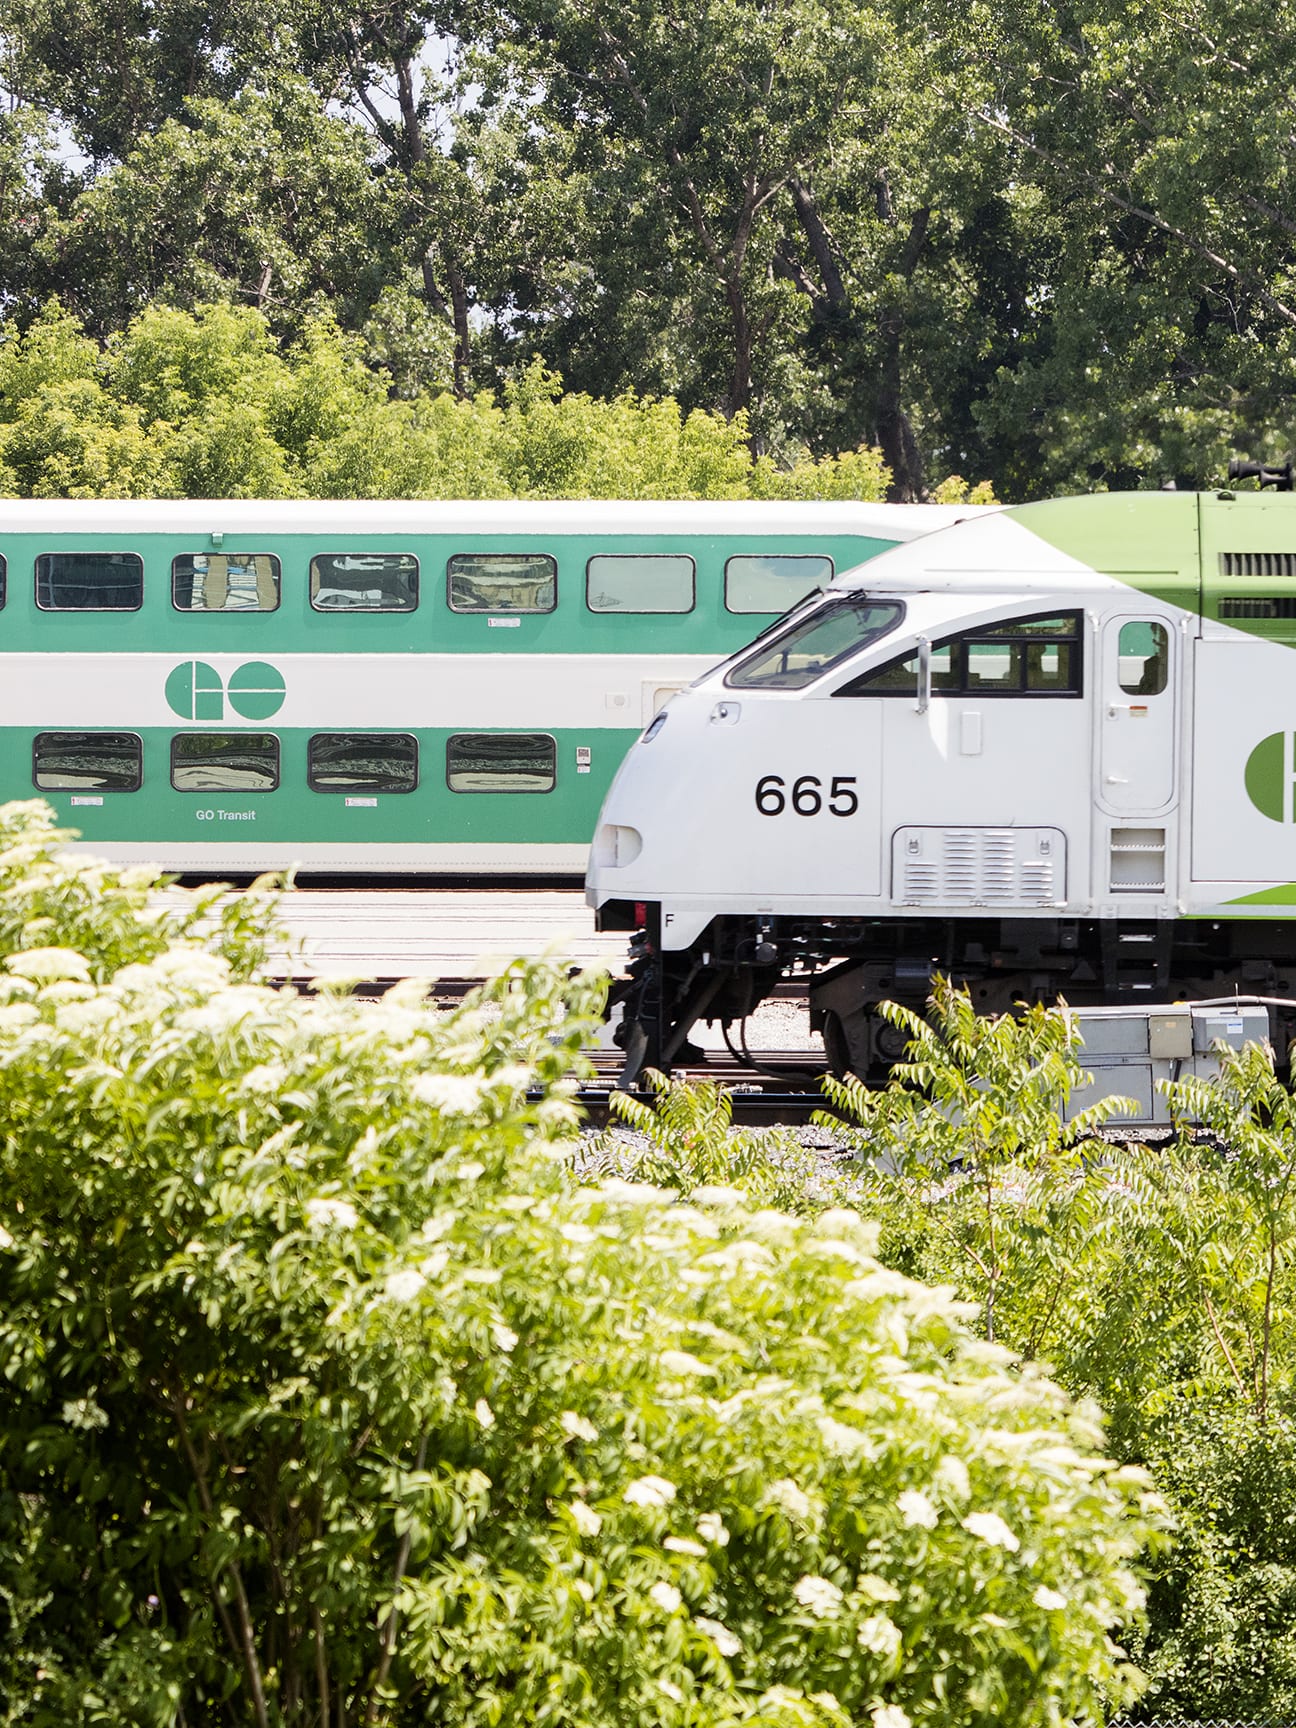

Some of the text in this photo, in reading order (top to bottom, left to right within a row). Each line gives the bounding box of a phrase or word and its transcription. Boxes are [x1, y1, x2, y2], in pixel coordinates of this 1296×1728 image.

[165, 661, 286, 721] GO
[755, 775, 859, 817] 665
[195, 809, 256, 821] GO Transit
[665, 913, 675, 928] F
